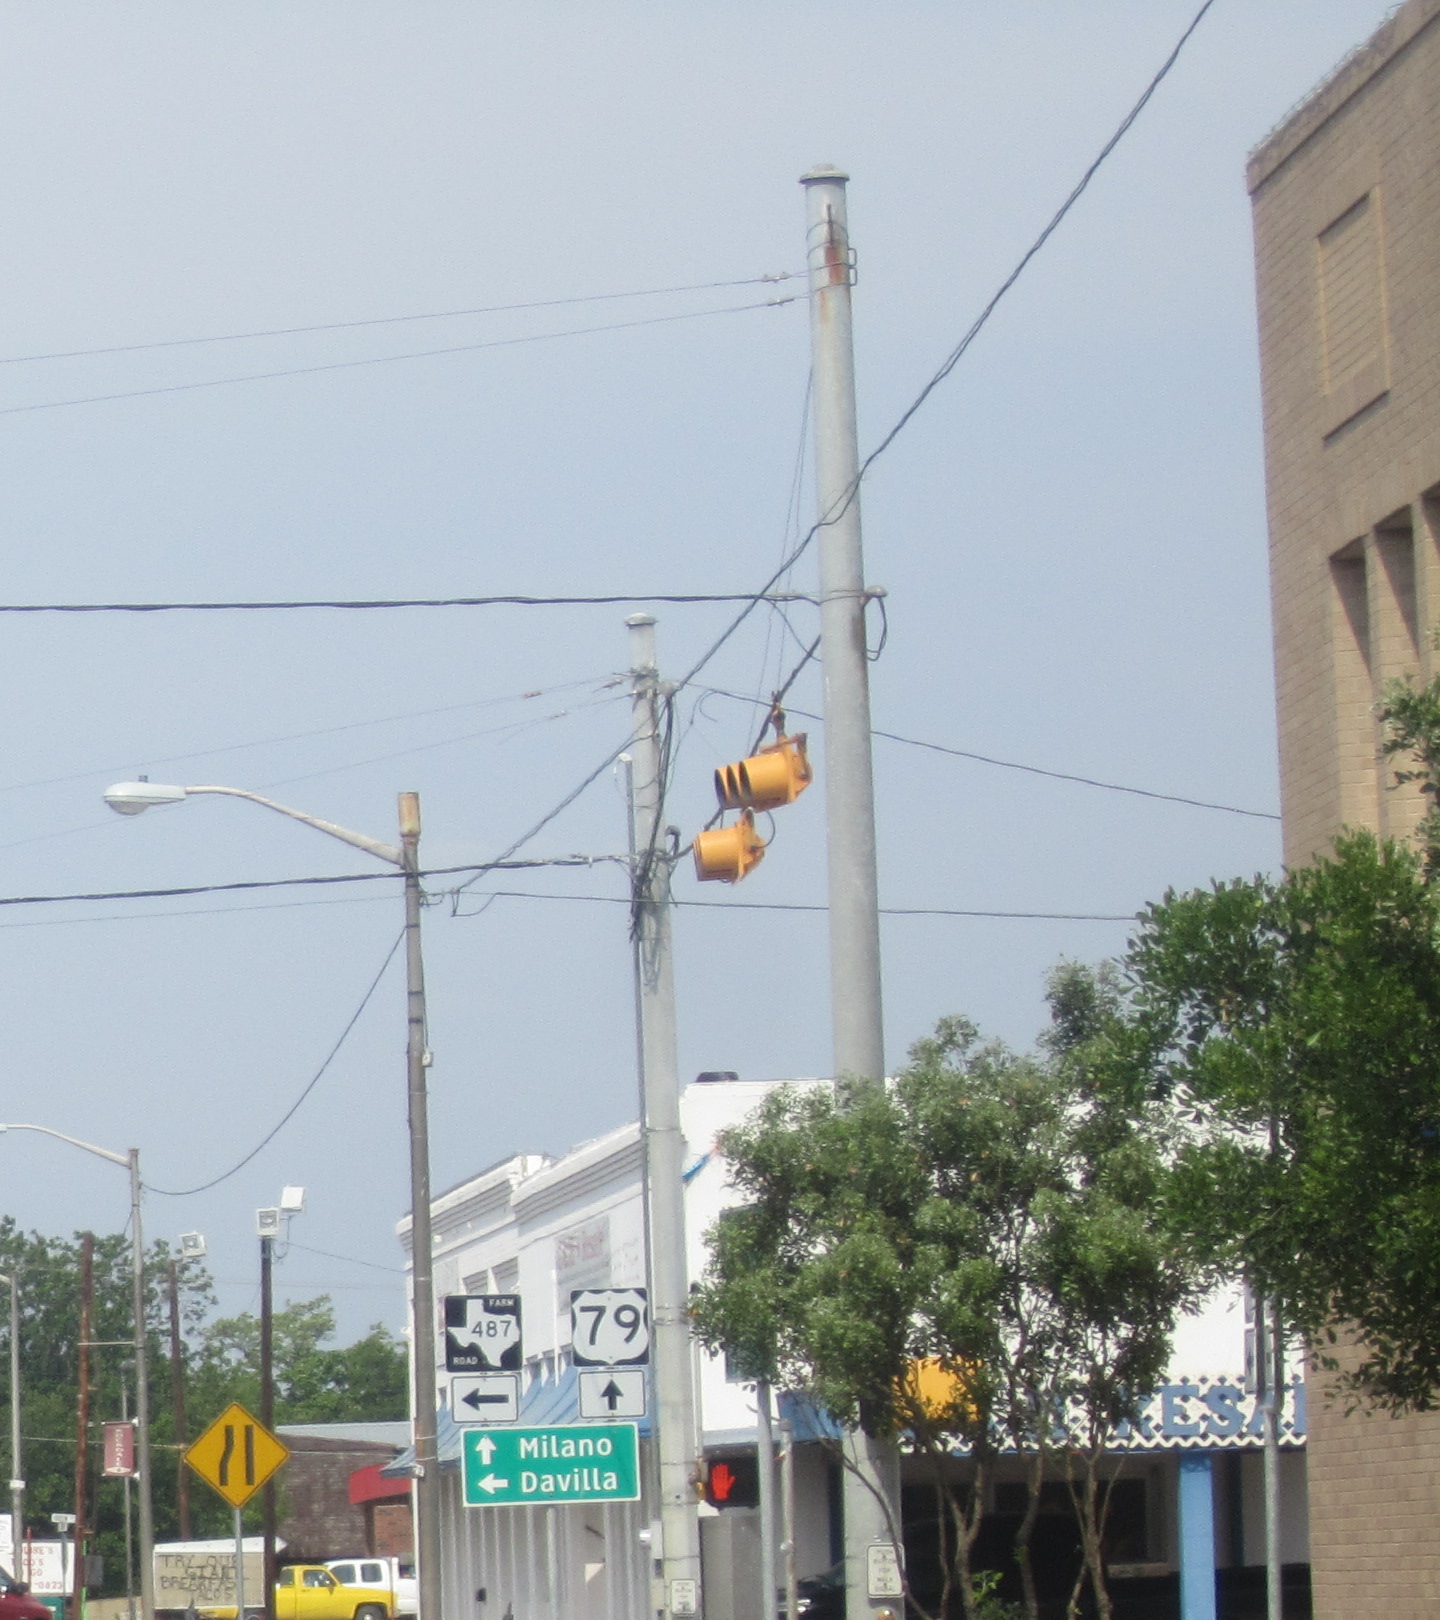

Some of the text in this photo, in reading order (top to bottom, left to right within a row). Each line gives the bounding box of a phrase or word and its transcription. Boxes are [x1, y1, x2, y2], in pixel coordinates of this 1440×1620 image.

[489, 1298, 514, 1307] FARM
[471, 1319, 512, 1338] 487
[578, 1304, 641, 1346] 79
[453, 1356, 478, 1365] ROAD
[520, 1435, 613, 1459] Milano
[521, 1467, 618, 1493] Davilla
[158, 1554, 196, 1568] TRY
